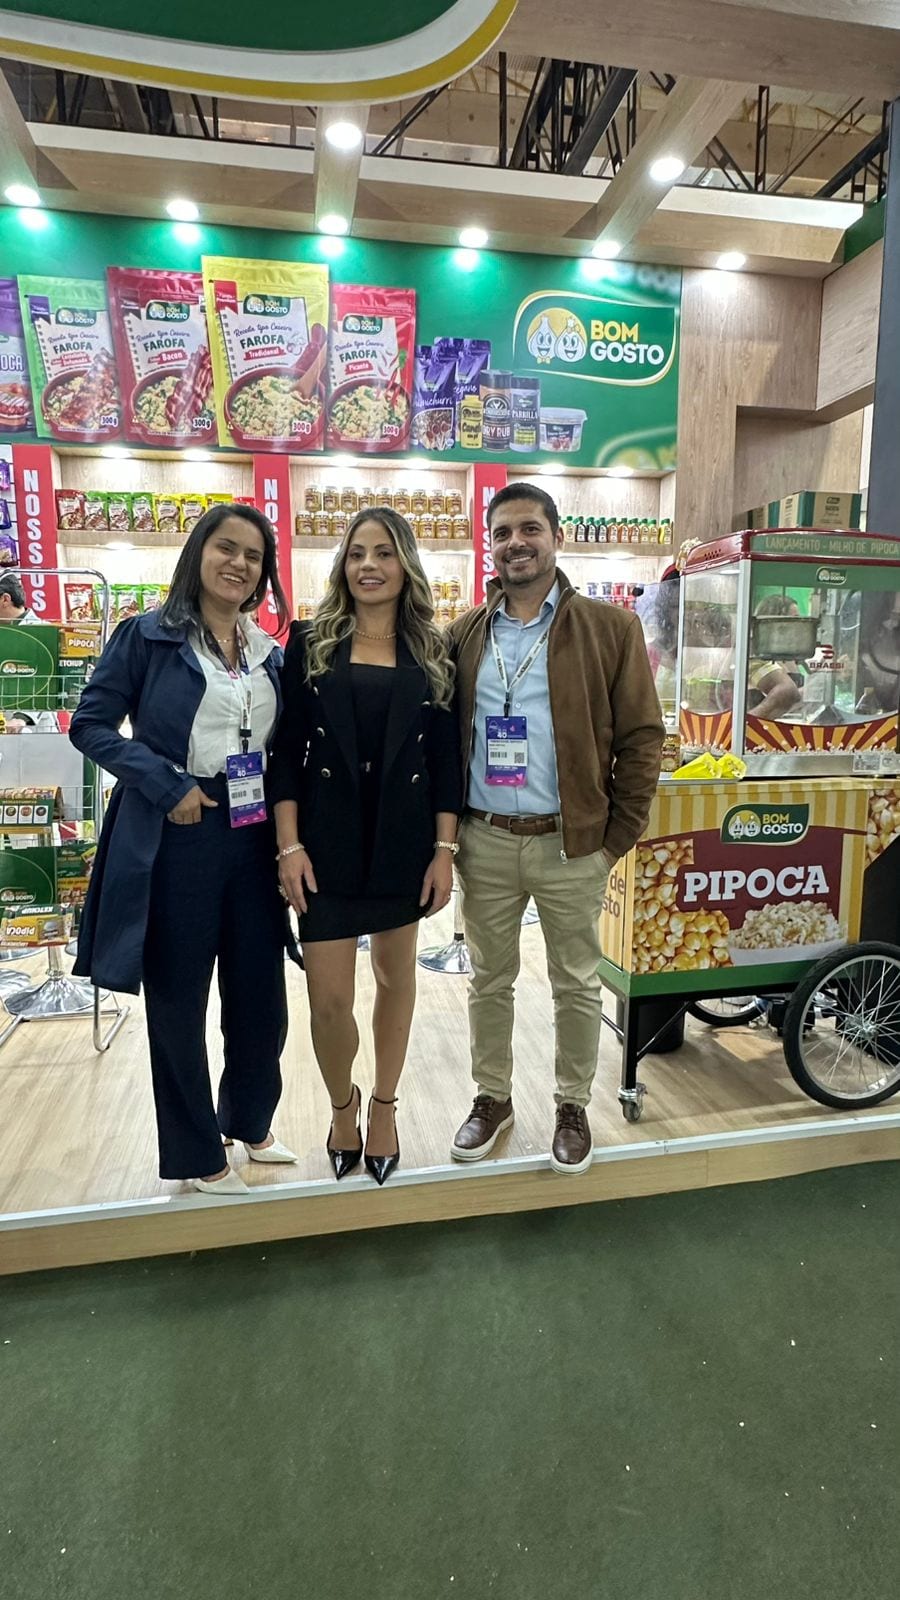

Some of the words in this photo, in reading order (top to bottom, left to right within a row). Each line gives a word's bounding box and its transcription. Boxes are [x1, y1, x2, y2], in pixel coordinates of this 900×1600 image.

[590, 319, 639, 343] BOM
[53, 341, 93, 354] FAROFA
[143, 338, 185, 352] FAROFA
[240, 334, 285, 349] FAROFA
[161, 352, 184, 361] Bacon
[339, 349, 377, 363] FAROFA
[590, 342, 665, 365] GOSTO
[0, 354, 23, 371] OCA
[68, 639, 95, 648] PIPOCA
[762, 813, 790, 824] BOM
[762, 822, 803, 835] GOSTO
[610, 870, 625, 895] de
[683, 865, 830, 903] PIPOCA
[602, 893, 620, 918] sto
[6, 926, 35, 935] PIPOCA
